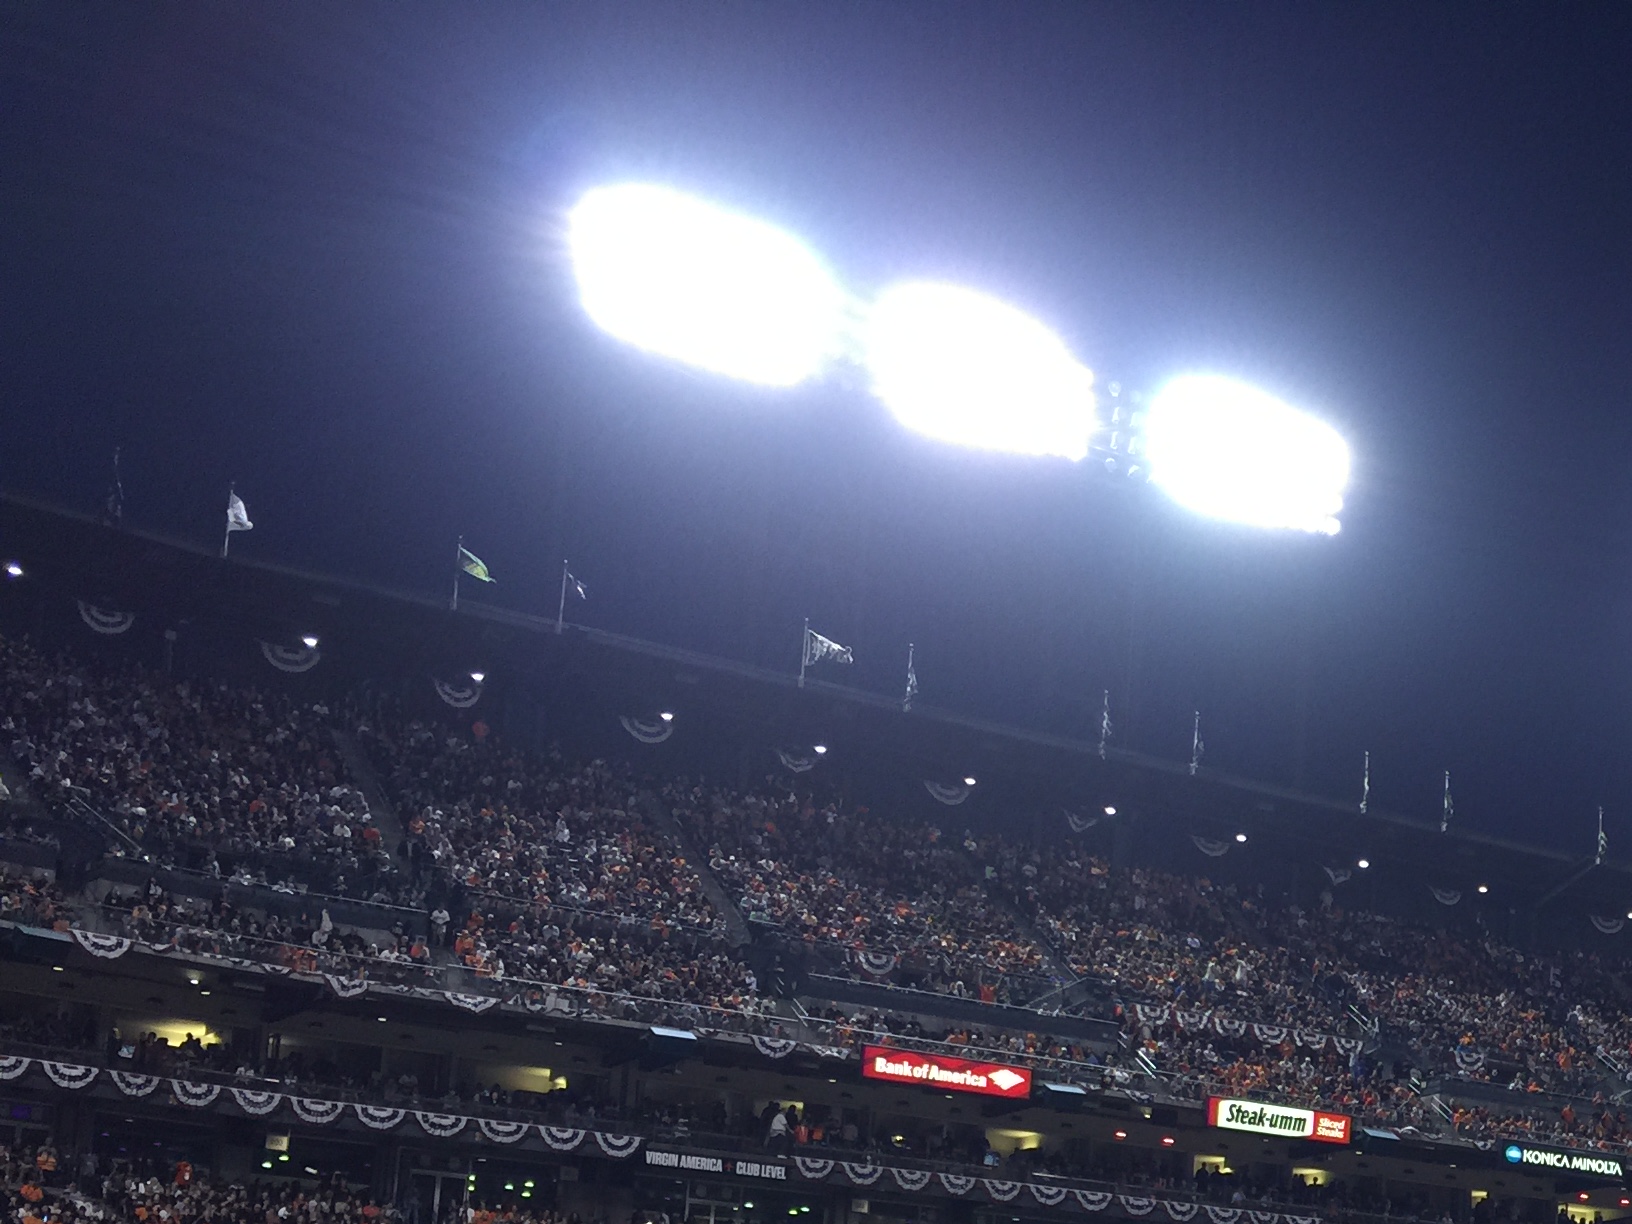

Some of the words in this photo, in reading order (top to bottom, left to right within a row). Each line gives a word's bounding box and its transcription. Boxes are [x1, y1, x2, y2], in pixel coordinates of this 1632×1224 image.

[875, 1057, 912, 1076] Bank
[913, 1063, 929, 1079] of
[929, 1065, 987, 1087] America
[1226, 1104, 1307, 1132] Steak-umm
[1319, 1118, 1346, 1130] Sliced
[1316, 1127, 1344, 1138] Steaks
[646, 1151, 678, 1167] VIRGIN
[680, 1155, 723, 1173] AMERICA
[736, 1161, 760, 1177] CLUB
[761, 1165, 787, 1180] LEVEL
[1523, 1149, 1570, 1168] KONICA
[1571, 1157, 1623, 1176] MINOLTA
